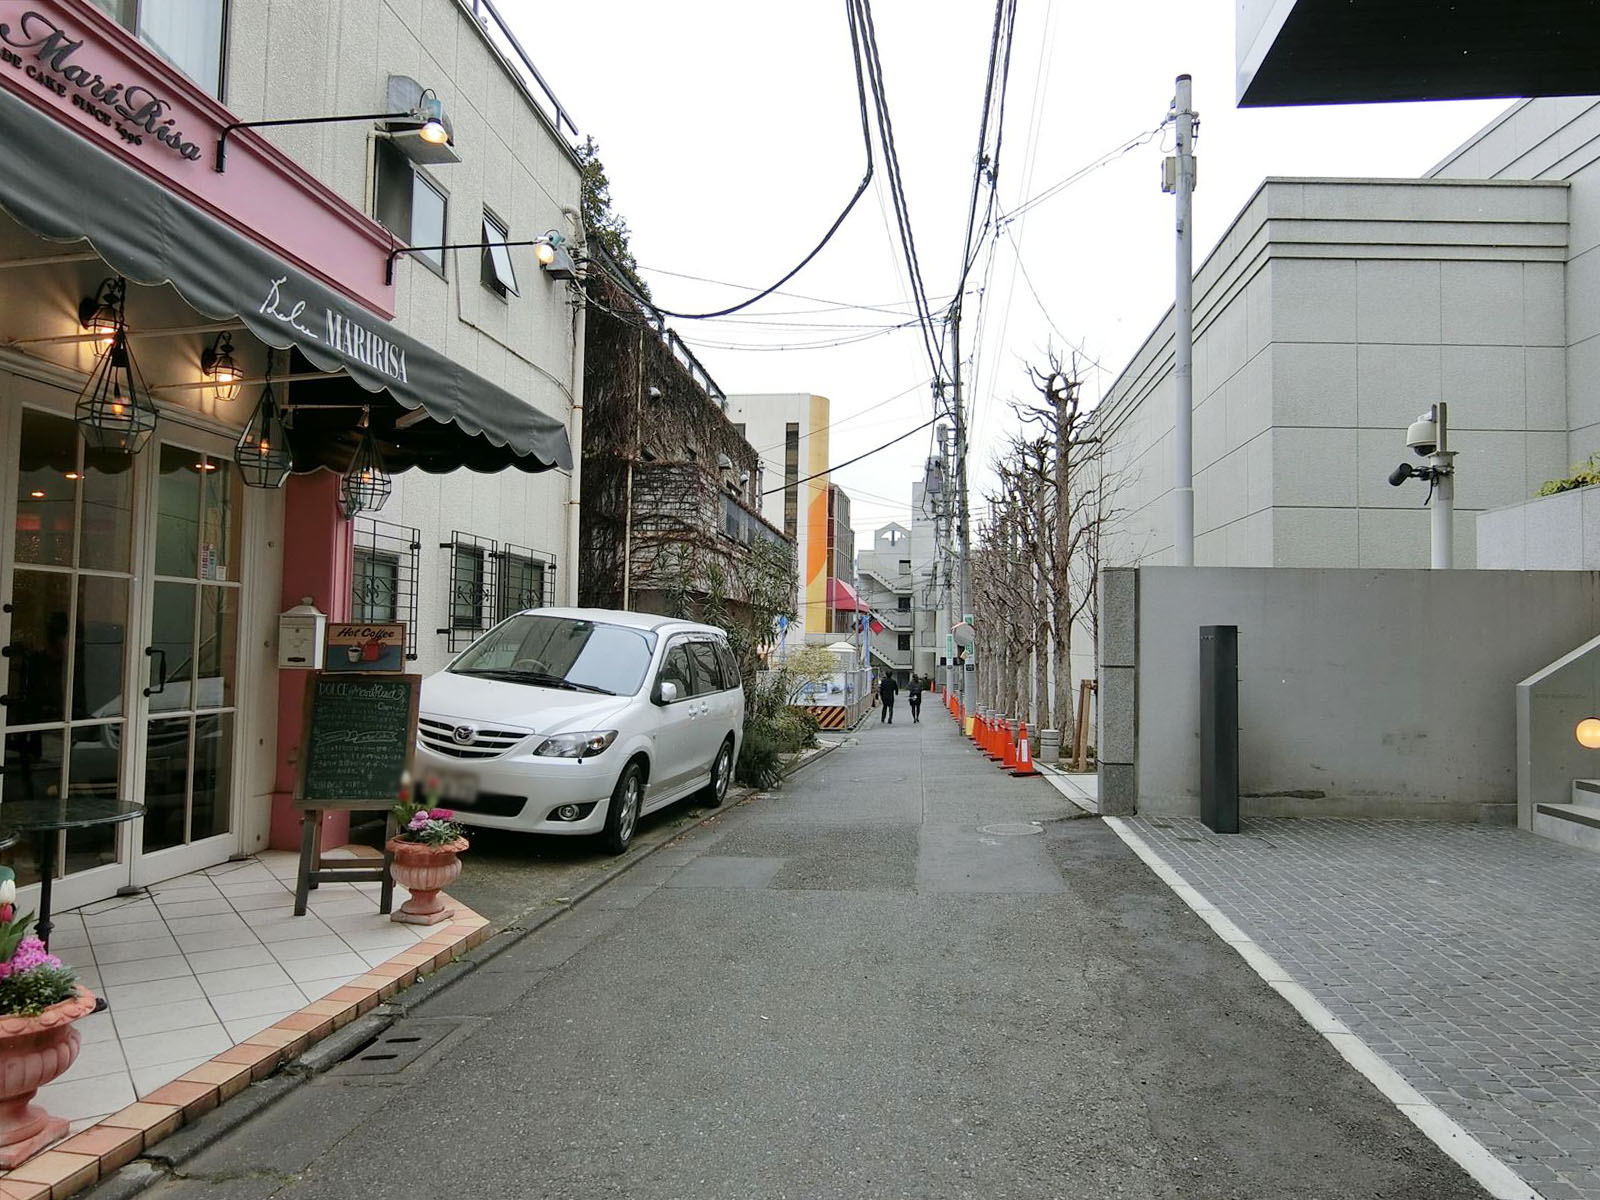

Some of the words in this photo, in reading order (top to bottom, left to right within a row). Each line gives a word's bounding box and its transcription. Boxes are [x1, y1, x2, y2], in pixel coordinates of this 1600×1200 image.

[25, 65, 67, 98] CAKE
[72, 93, 112, 127] SINCE
[325, 308, 408, 384] MARIRISA
[336, 627, 360, 638] Hot
[361, 627, 395, 640] Coffee
